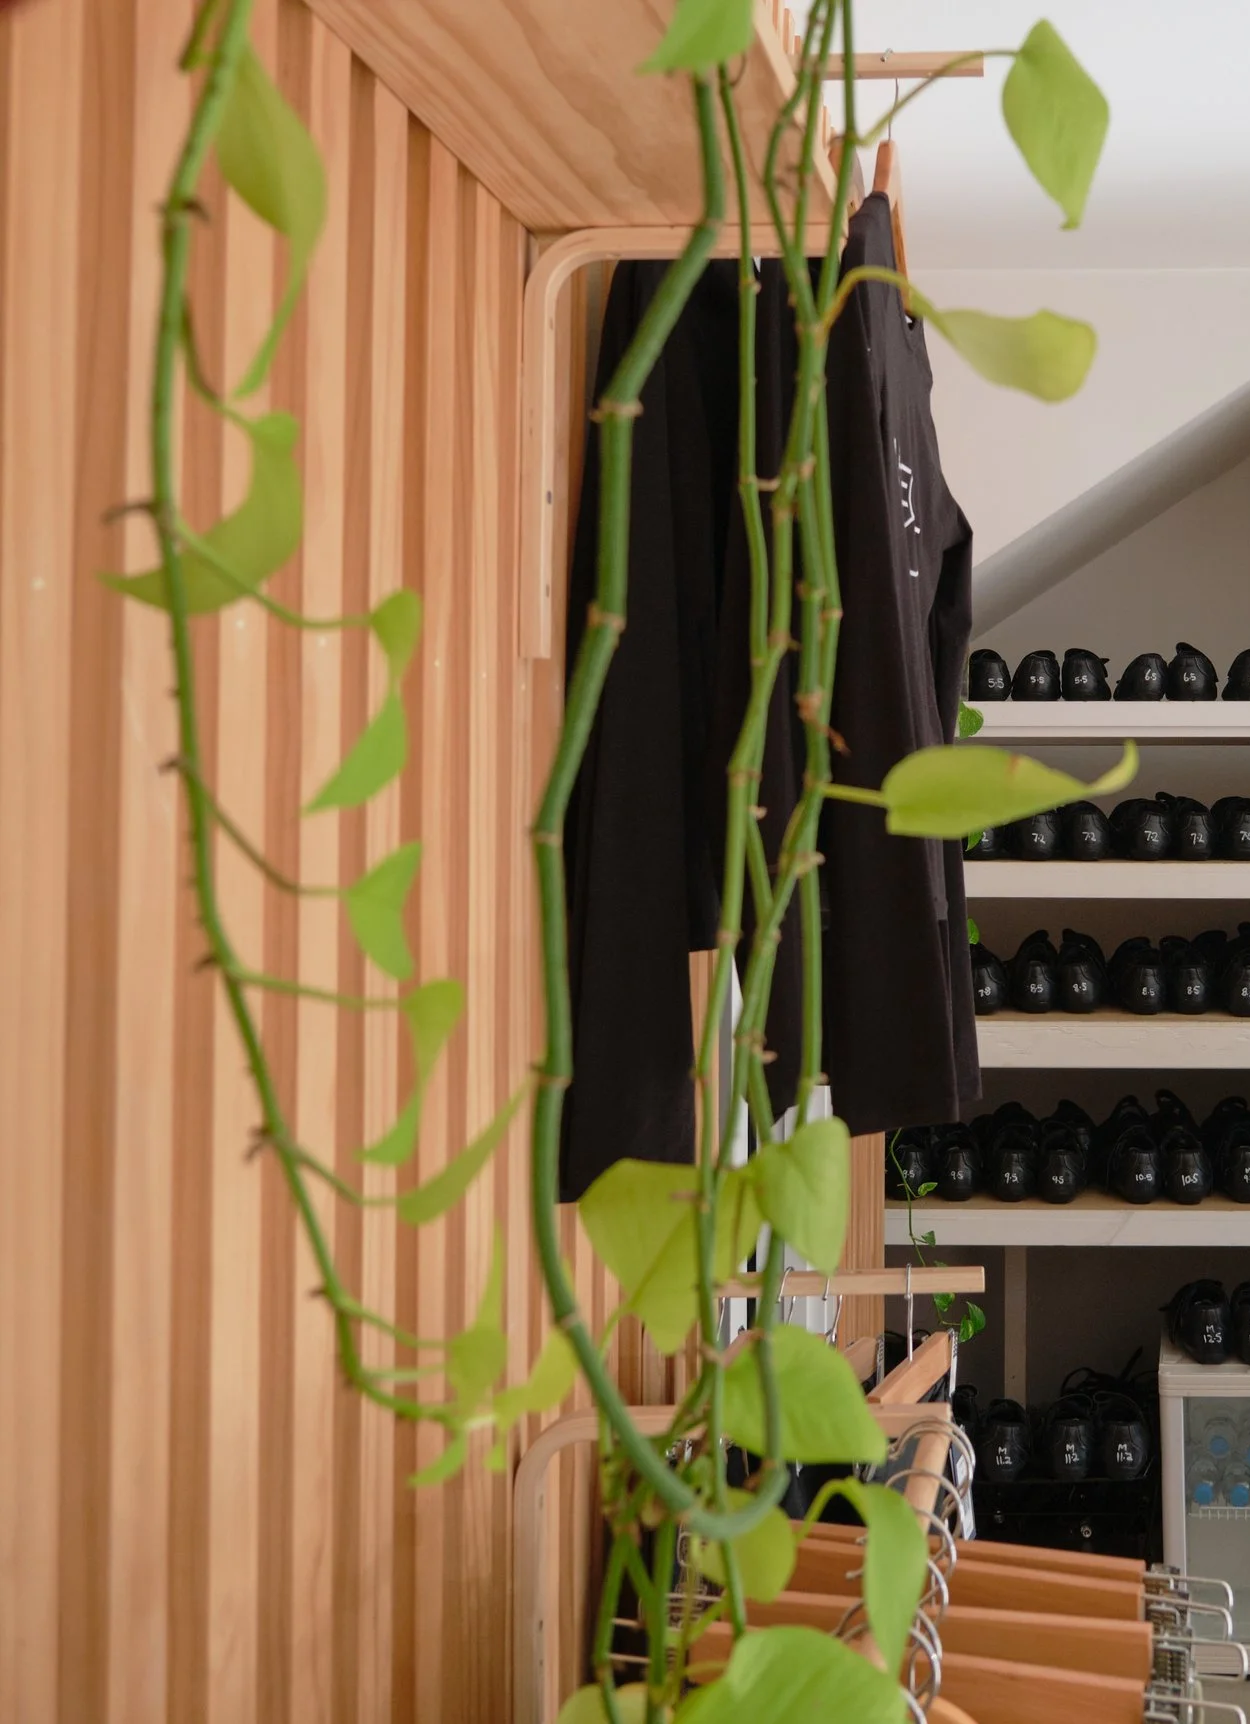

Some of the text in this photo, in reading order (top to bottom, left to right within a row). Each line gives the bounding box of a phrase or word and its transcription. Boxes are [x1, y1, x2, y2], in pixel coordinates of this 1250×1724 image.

[1030, 675, 1045, 684] 5.5
[1074, 675, 1088, 684] 5.5
[1145, 669, 1157, 680] 6.5
[1183, 672, 1196, 681] 6.5
[988, 678, 1005, 689] 5.5
[1032, 833, 1045, 844] 7.2
[1082, 831, 1097, 842] 7.2
[1144, 830, 1159, 842] 7.2
[1190, 833, 1205, 844] 7.2
[1030, 983, 1044, 993] 8.5
[951, 1170, 964, 1181] 9.5
[1005, 1172, 1017, 1184] 9.5
[1052, 1175, 1064, 1185] 9.5
[1182, 1173, 1199, 1186] 10.5
[1205, 1325, 1214, 1333] M
[1203, 1332, 1223, 1344] 12.5
[998, 1447, 1007, 1455] M
[1066, 1443, 1075, 1452] M
[1117, 1443, 1127, 1452] M
[996, 1456, 1013, 1465] 11.2
[1065, 1453, 1079, 1464] 11.2
[1117, 1452, 1133, 1462] 11.2
